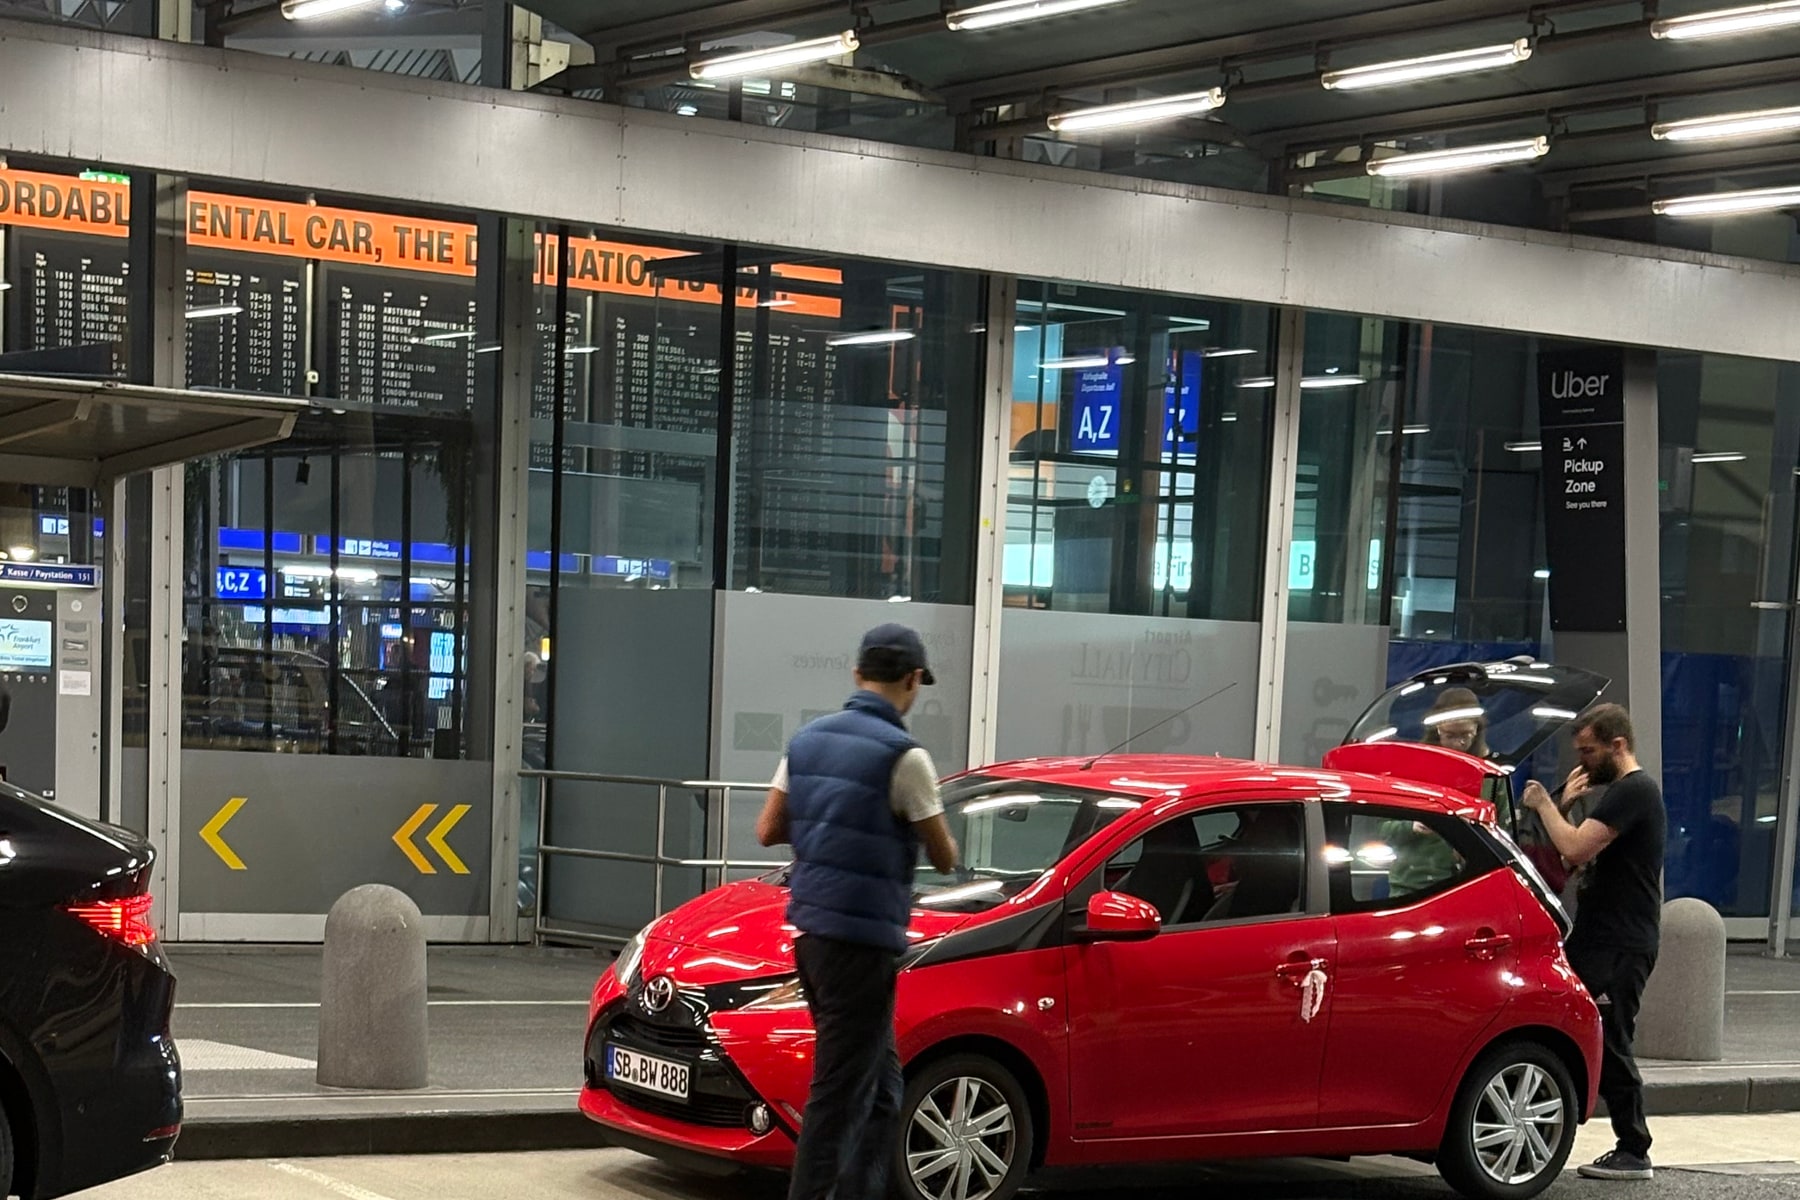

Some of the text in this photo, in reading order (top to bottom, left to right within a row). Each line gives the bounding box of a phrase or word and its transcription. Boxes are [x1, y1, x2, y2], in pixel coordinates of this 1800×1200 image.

[189, 201, 295, 246] ENTAL
[305, 215, 383, 263] CAR,
[393, 225, 454, 265] THE
[1551, 370, 1609, 399] Uber
[1078, 405, 1113, 443] A,Z
[1564, 458, 1604, 475] Pickup
[1565, 479, 1596, 494] Zone
[1565, 500, 1607, 510] See you there
[7, 567, 29, 577] Kasse
[35, 569, 73, 580] Paystation
[614, 1050, 688, 1095] SB BW 888
